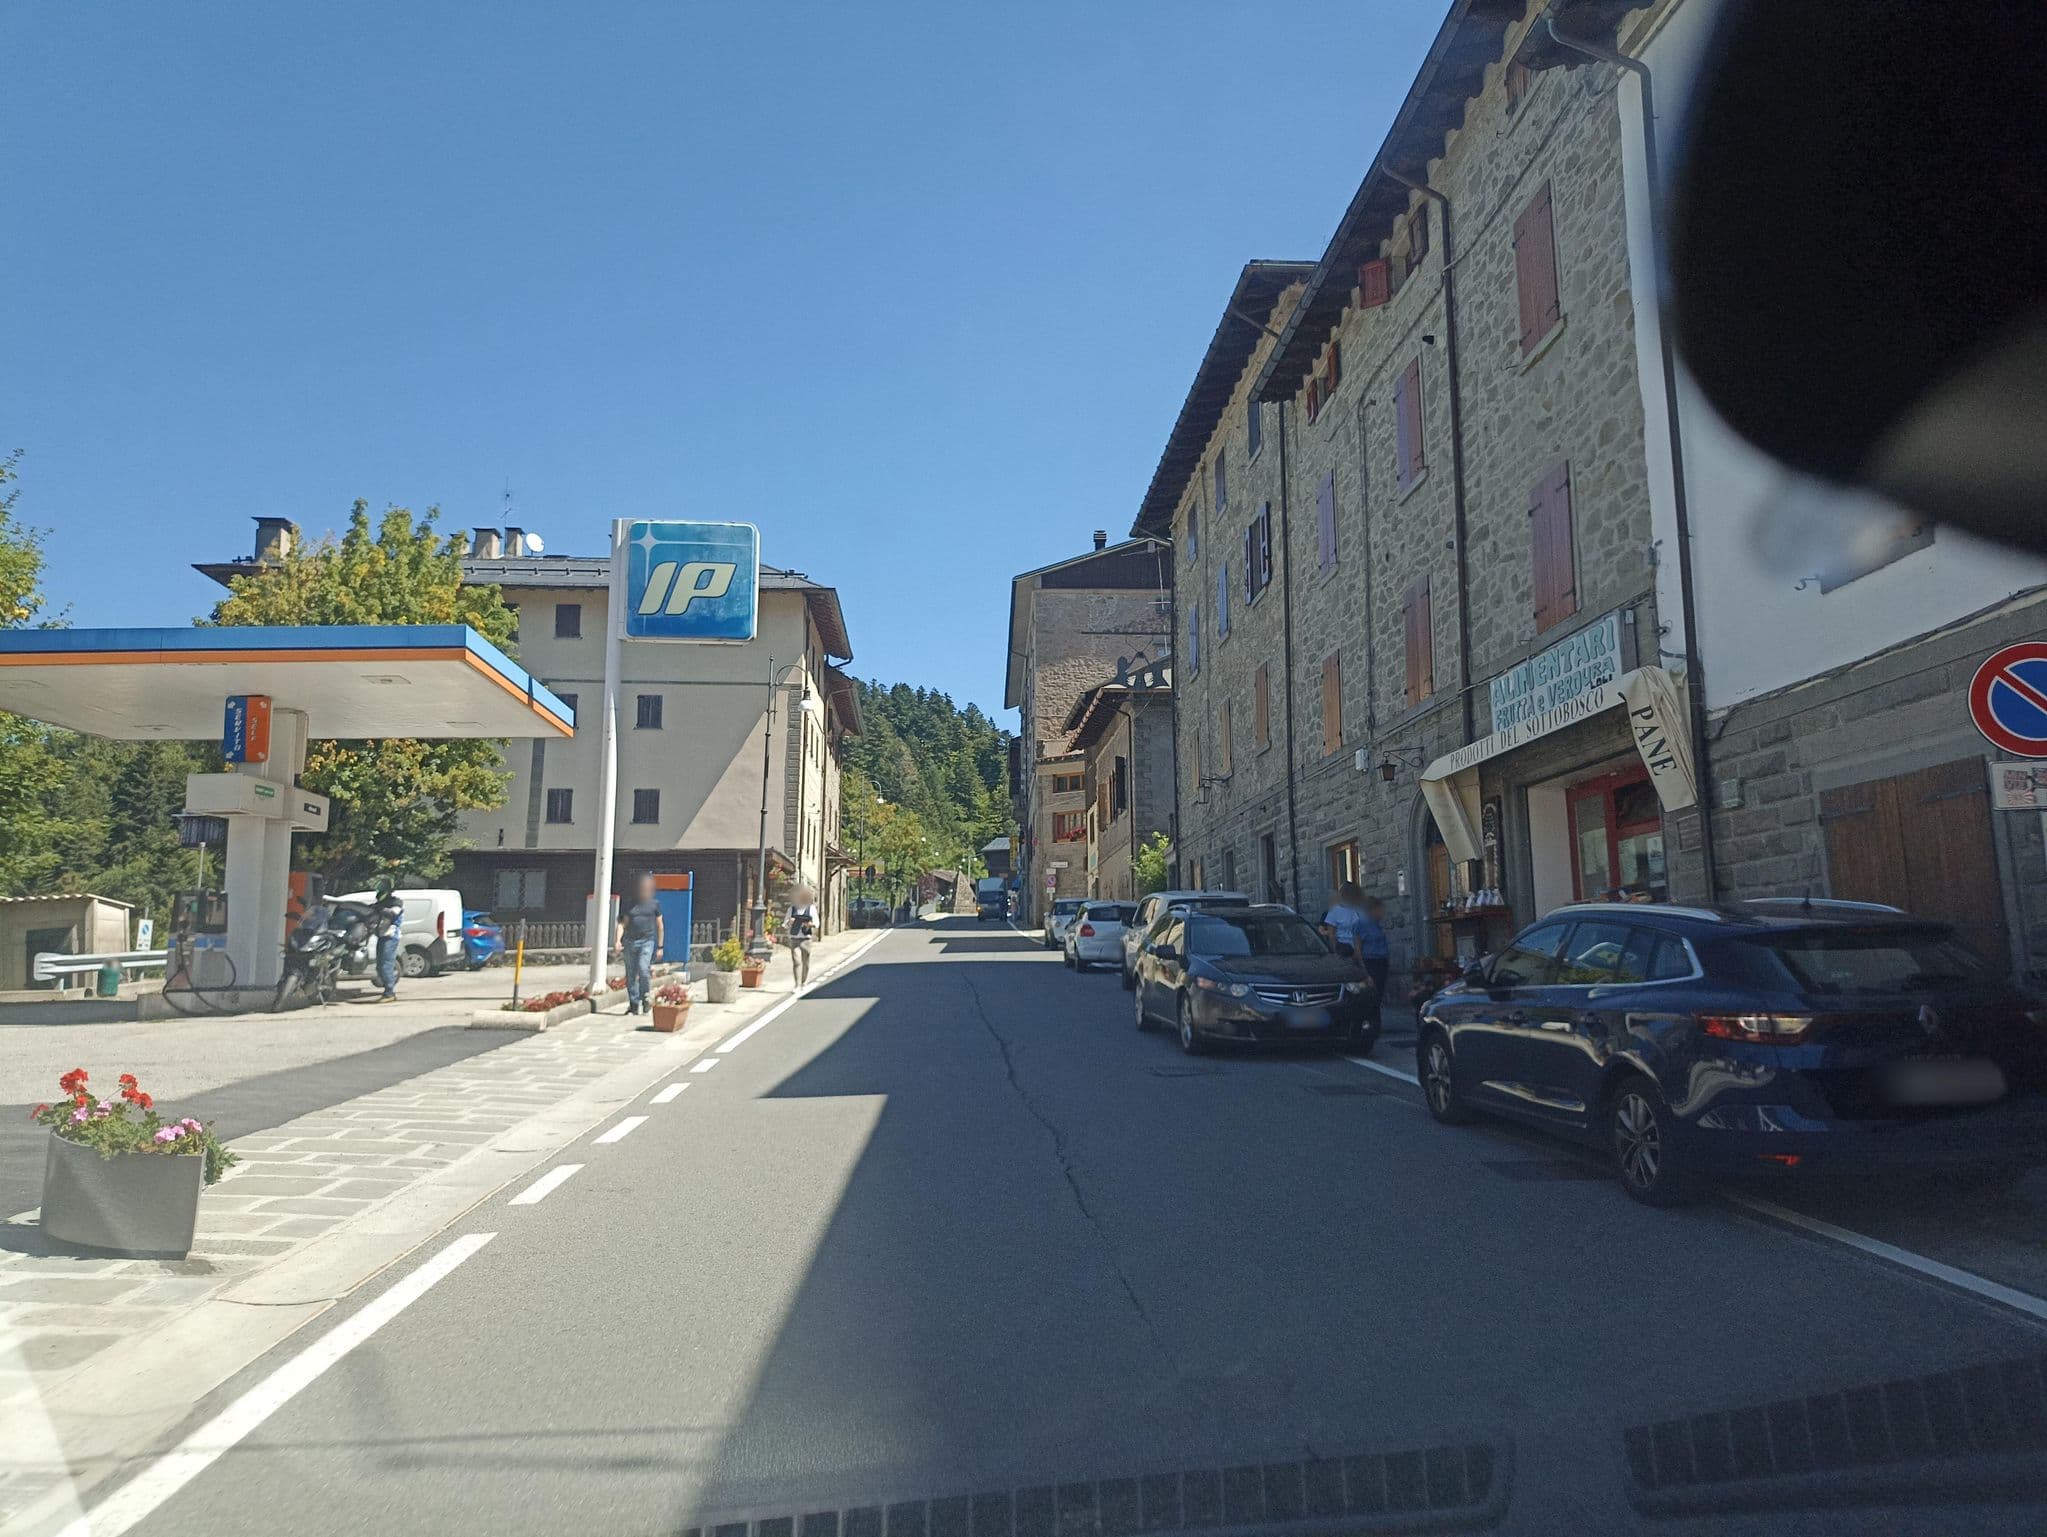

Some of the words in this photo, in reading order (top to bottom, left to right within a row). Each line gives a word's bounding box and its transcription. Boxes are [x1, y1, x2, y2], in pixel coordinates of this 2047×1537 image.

[638, 561, 737, 615] IP
[1492, 618, 1616, 707] ALIMENTARI
[1496, 698, 1536, 731] FRUTTA
[1537, 696, 1546, 714] e
[1547, 657, 1616, 707] VERDURA
[1449, 739, 1496, 770] PRODOTTI
[1500, 729, 1520, 750] DEL
[1526, 687, 1604, 736] SOTTOBOSCO
[1632, 704, 1678, 777] PANE
